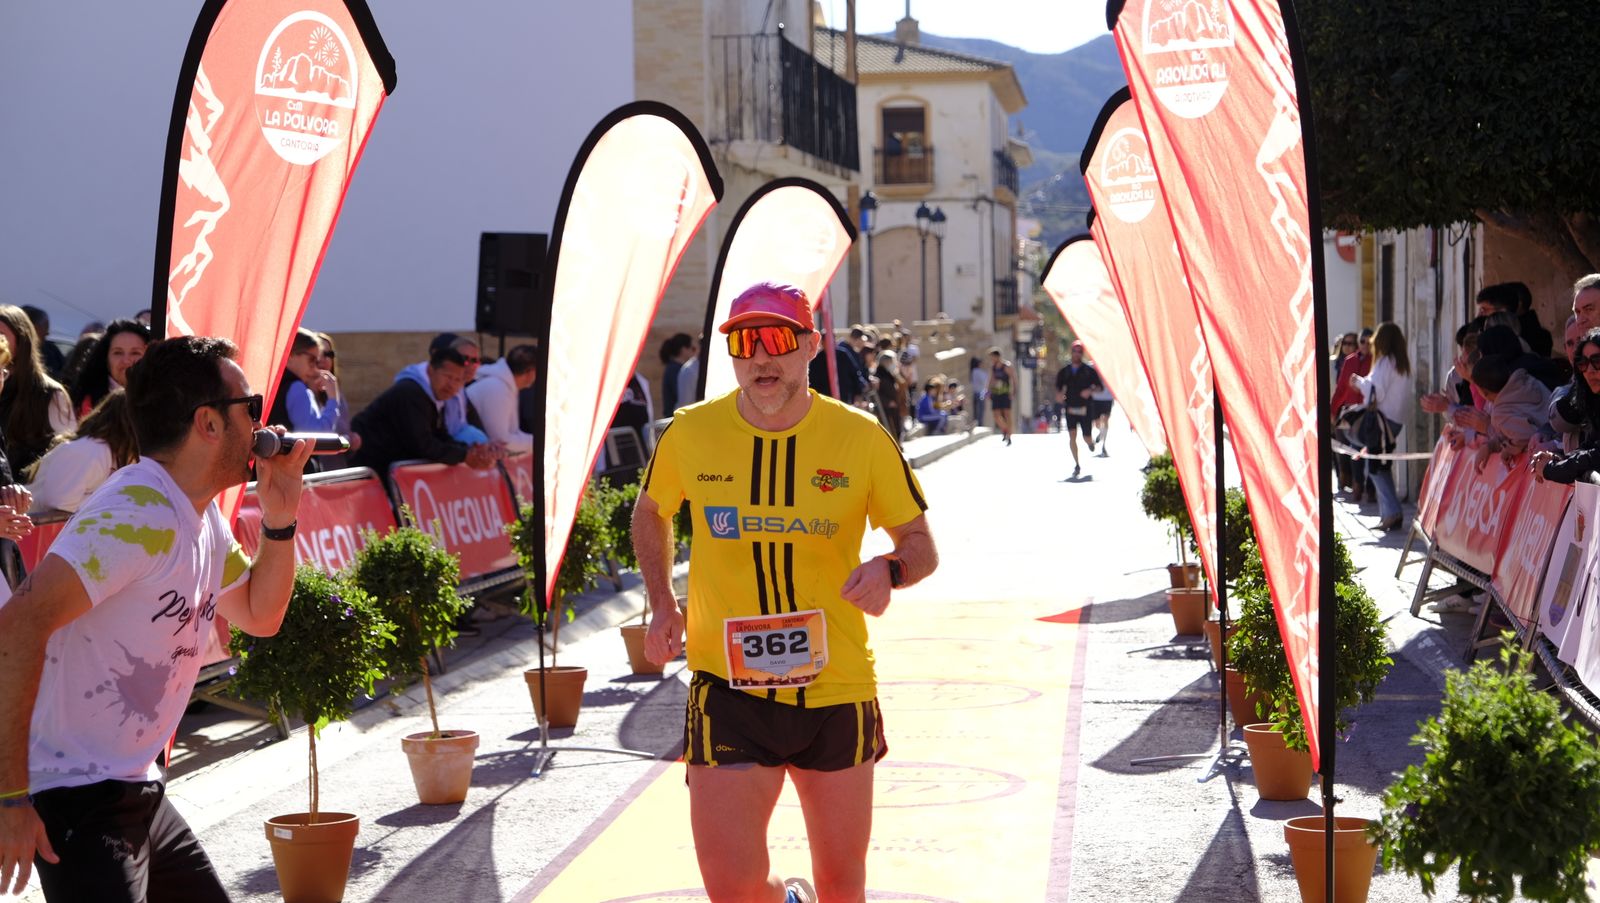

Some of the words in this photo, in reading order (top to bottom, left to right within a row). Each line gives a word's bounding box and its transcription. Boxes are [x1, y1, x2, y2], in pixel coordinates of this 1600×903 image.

[265, 109, 281, 126] LA
[441, 495, 506, 546] VEOLIA
[743, 630, 809, 658] 362
